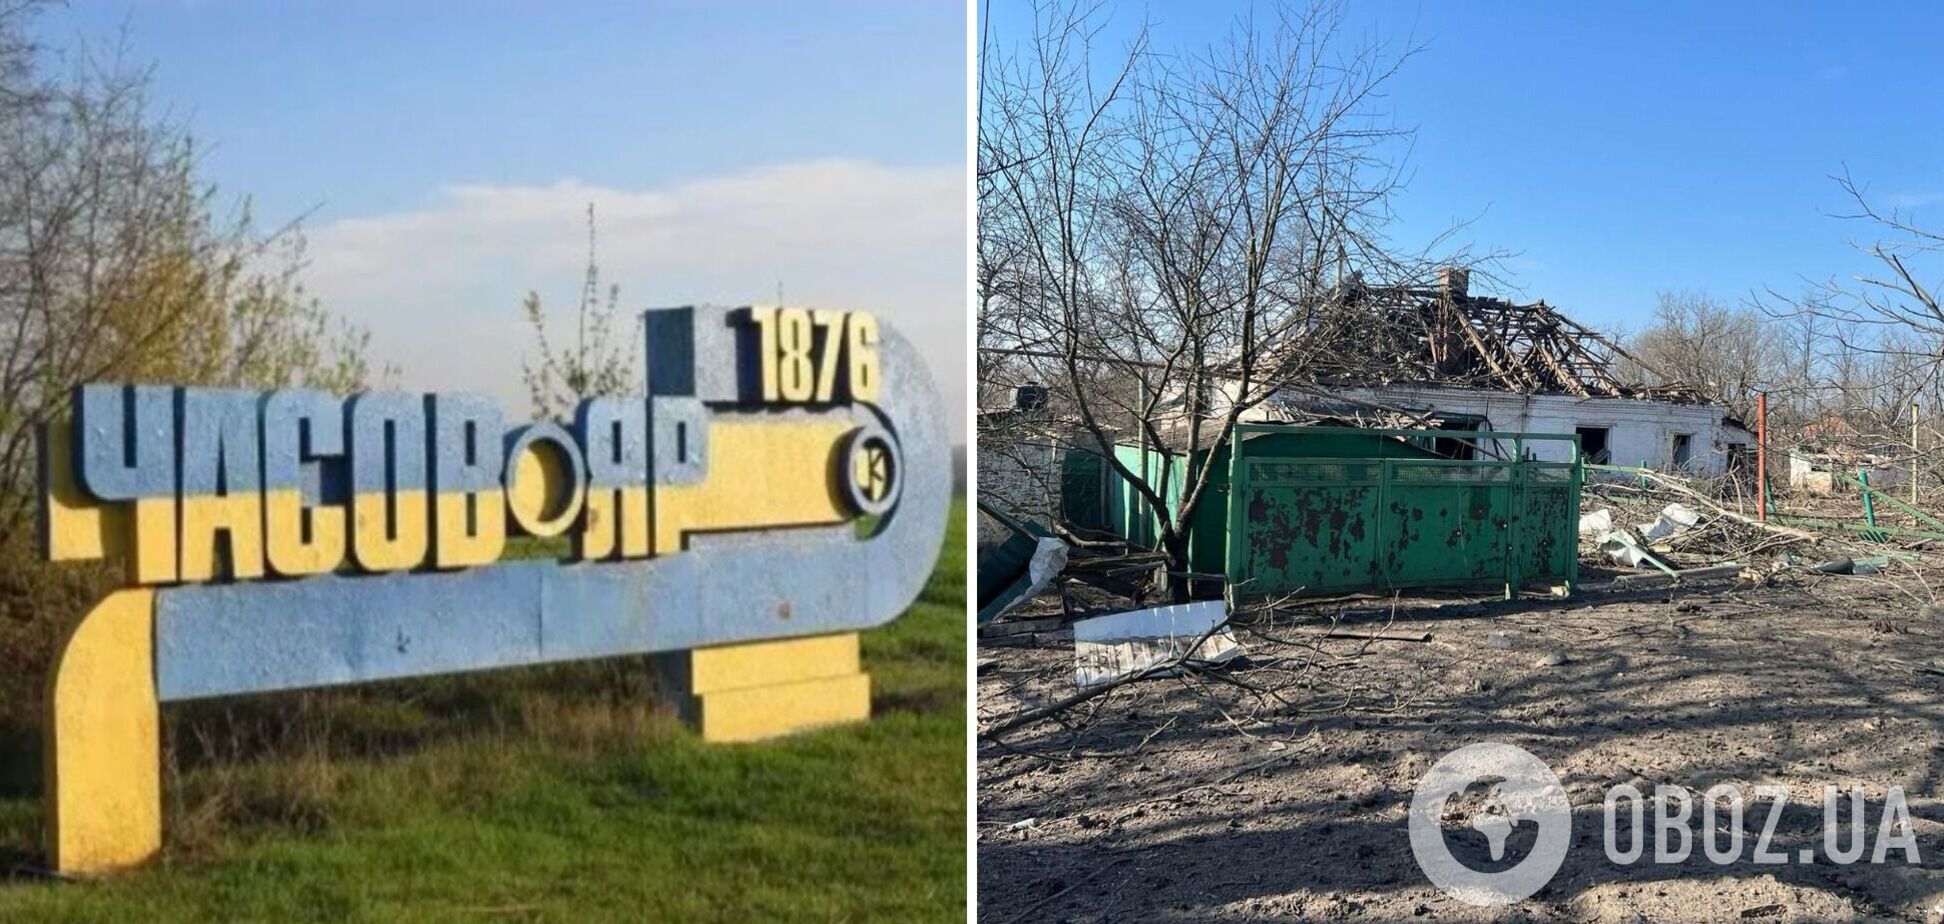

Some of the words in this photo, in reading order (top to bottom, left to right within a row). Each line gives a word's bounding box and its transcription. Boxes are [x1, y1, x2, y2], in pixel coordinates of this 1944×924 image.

[751, 305, 880, 402] 1876
[80, 384, 506, 583] ЧАСОВ
[583, 396, 710, 559] ЯР
